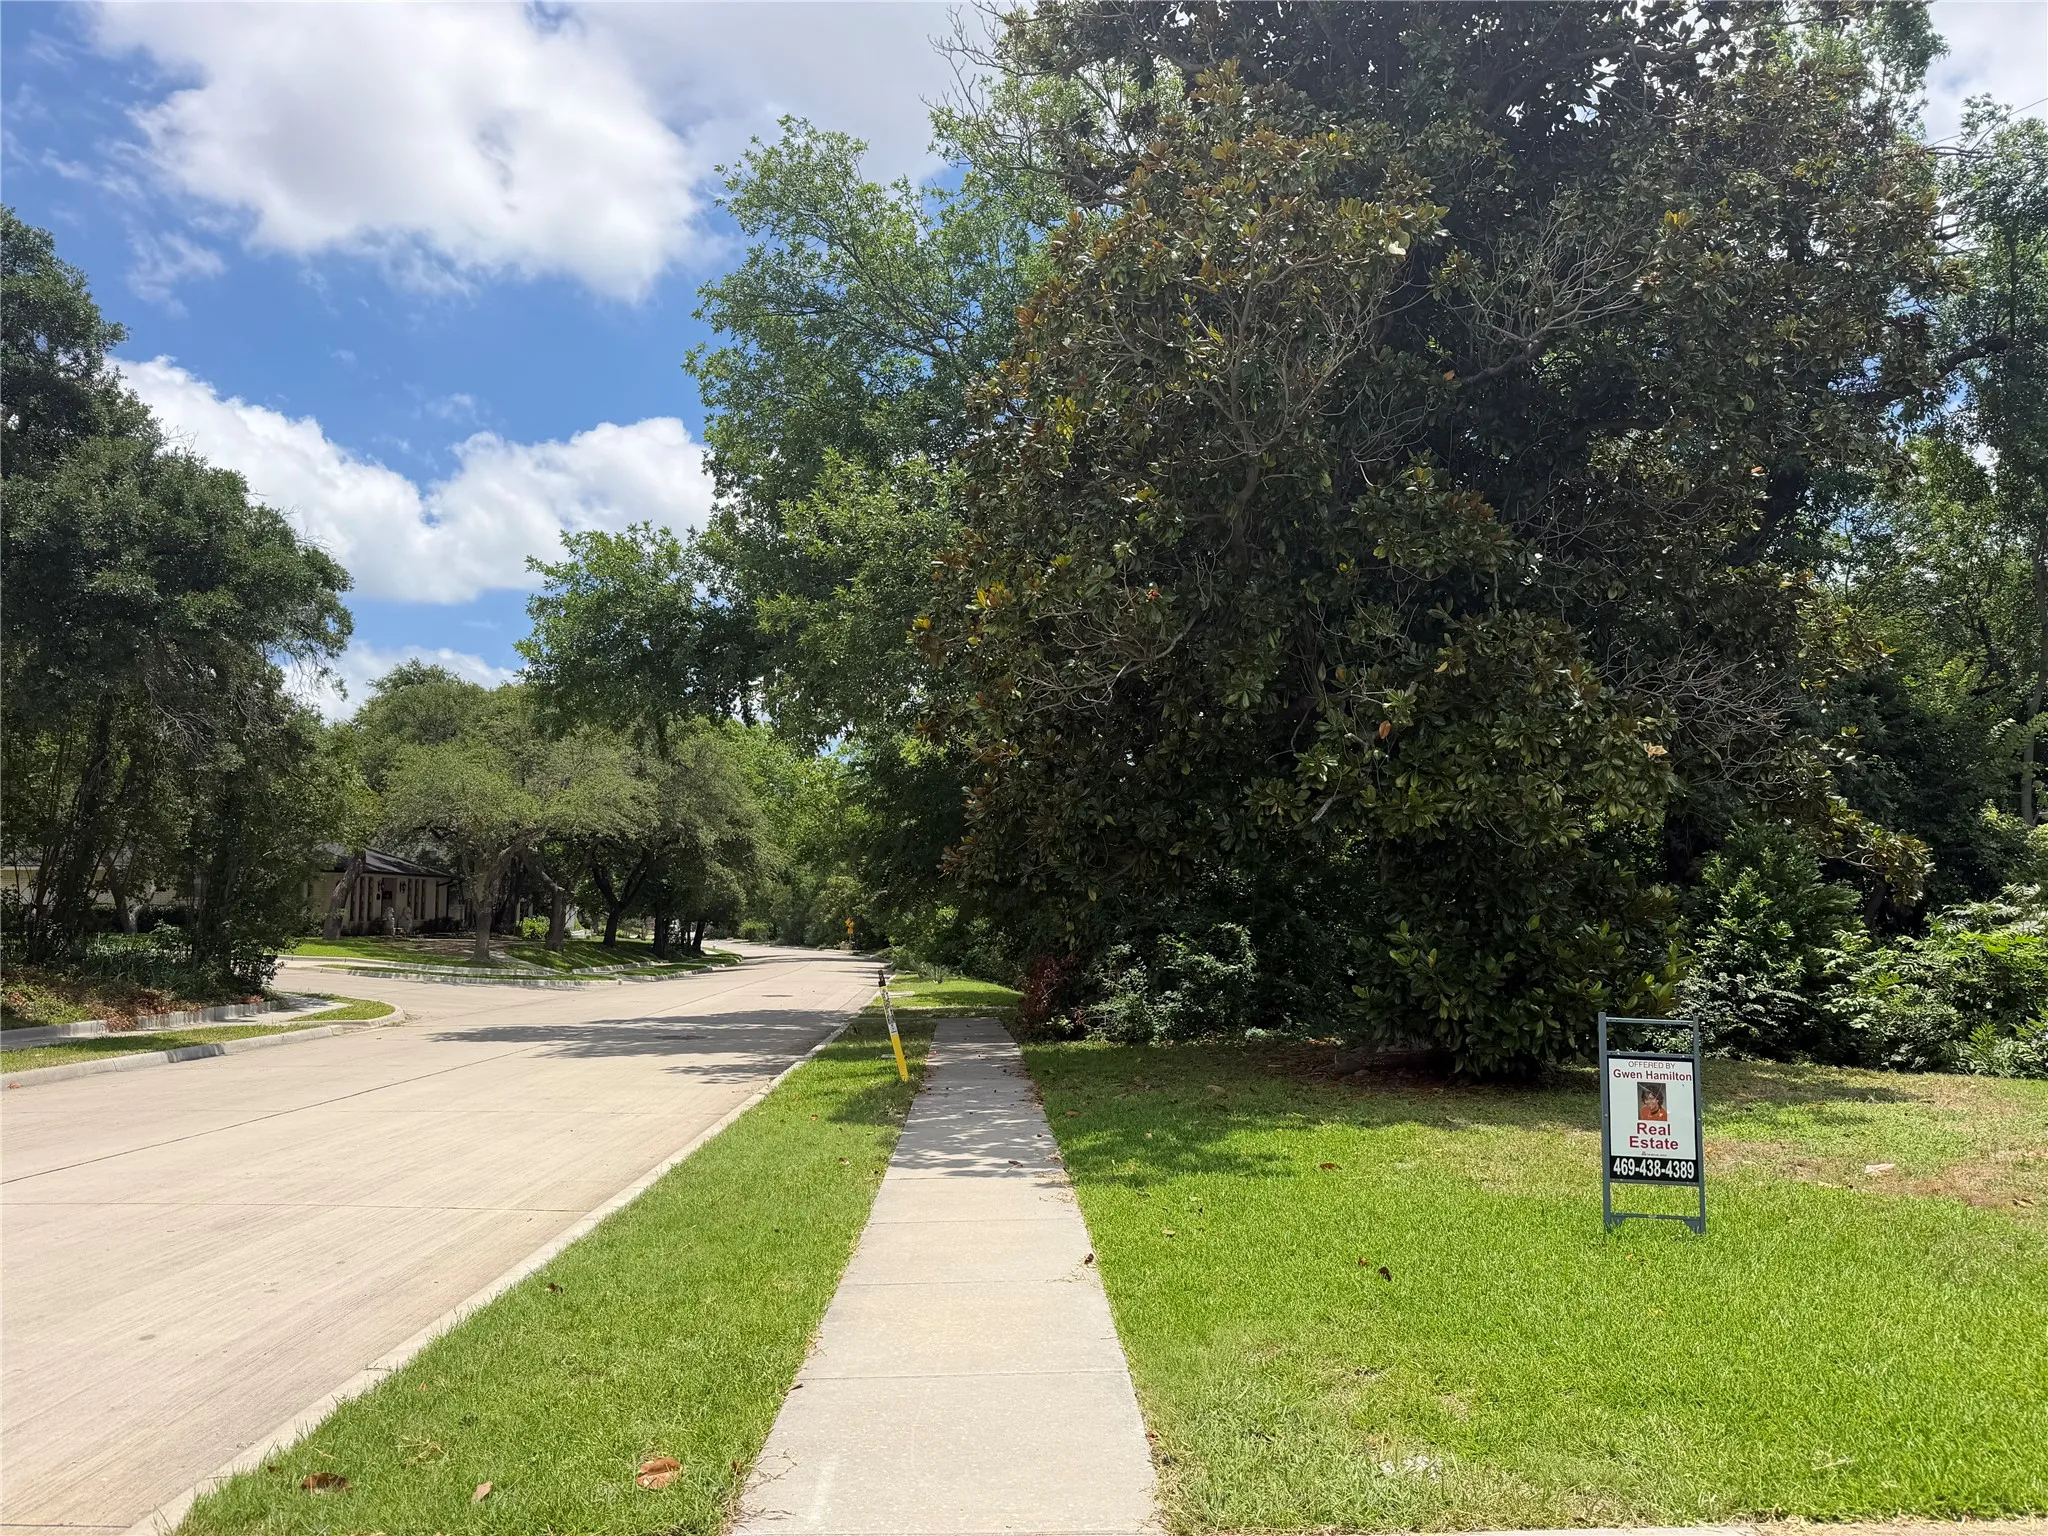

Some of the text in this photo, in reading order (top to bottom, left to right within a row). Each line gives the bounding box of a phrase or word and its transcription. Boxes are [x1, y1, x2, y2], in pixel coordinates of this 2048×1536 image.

[1628, 1060, 1676, 1070] OFFERED BY
[1613, 1068, 1692, 1082] Gwen Hamilton
[1636, 1122, 1671, 1136] Real
[1629, 1135, 1679, 1150] Estate
[1613, 1157, 1695, 1179] 469-438-4389
